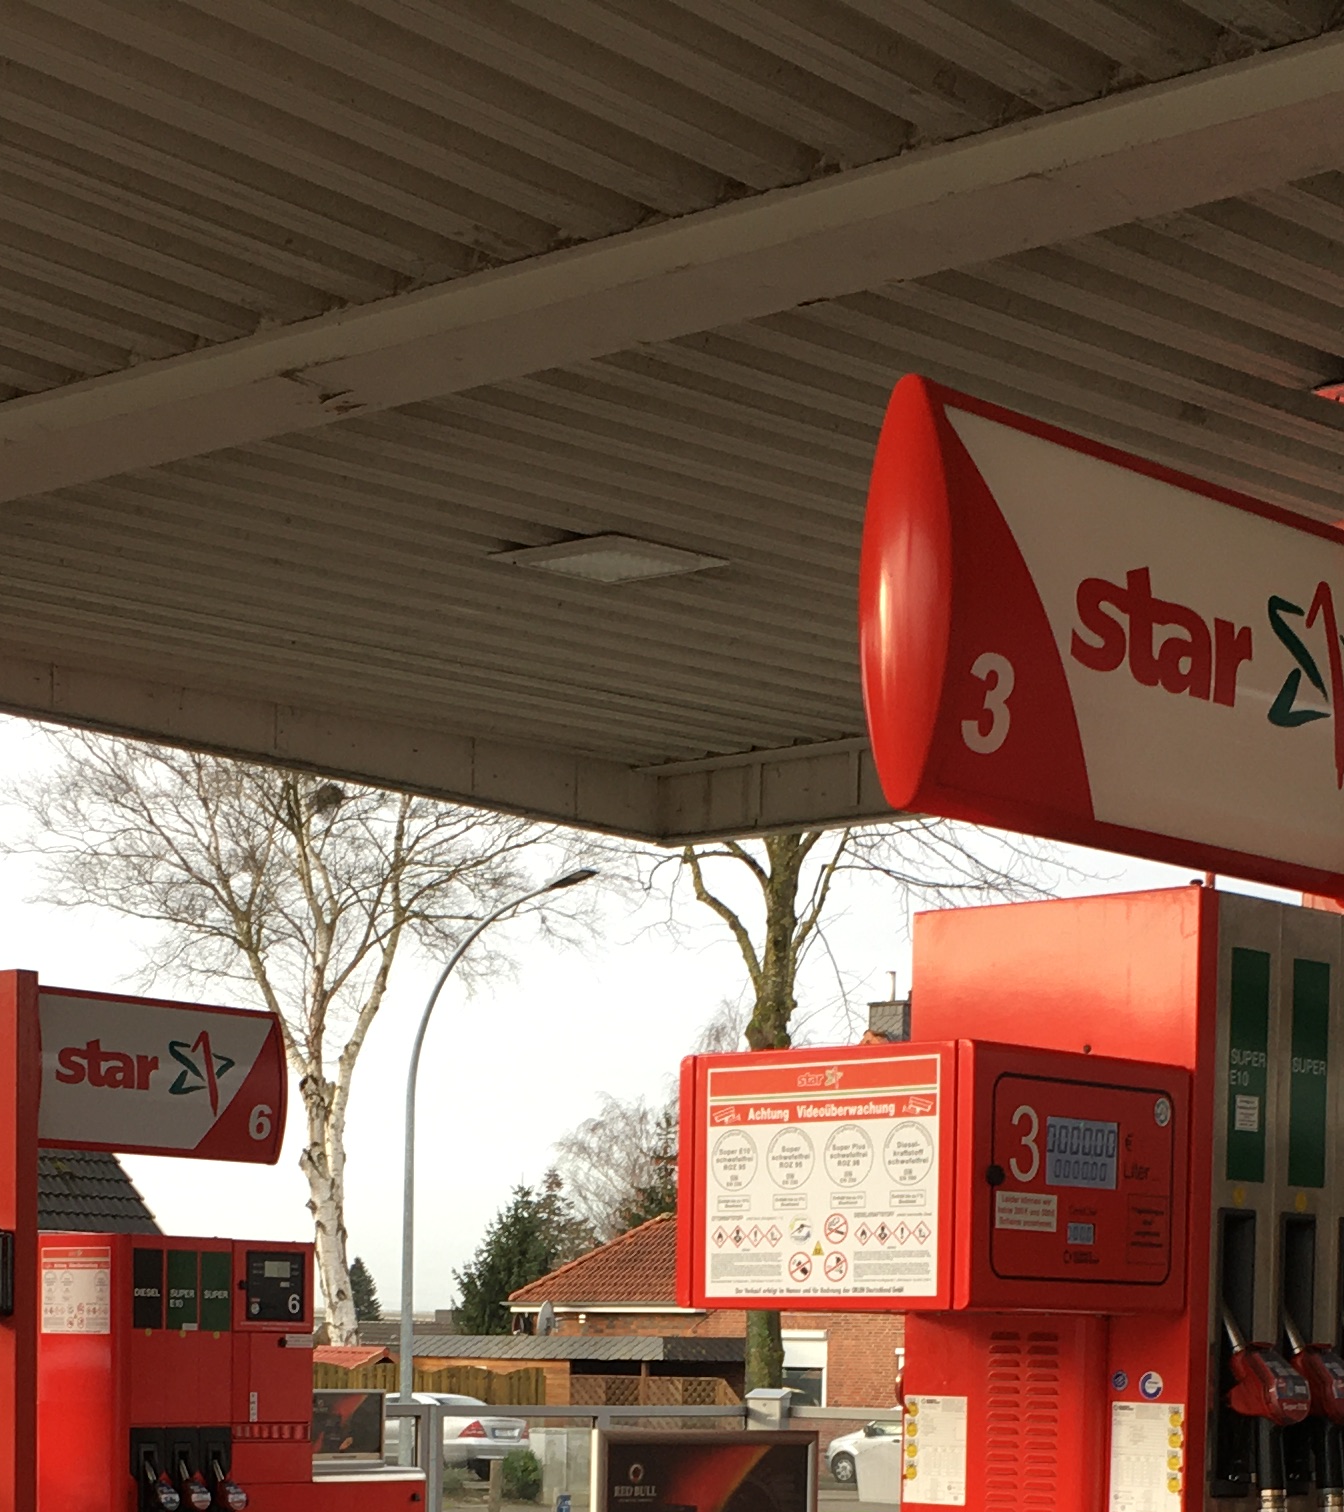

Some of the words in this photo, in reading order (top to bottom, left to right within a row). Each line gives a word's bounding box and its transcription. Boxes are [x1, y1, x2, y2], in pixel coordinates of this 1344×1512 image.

[1070, 566, 1253, 706] star
[960, 652, 1015, 755] 3
[56, 1038, 159, 1091] star
[1231, 1048, 1266, 1068] SUPER
[1292, 1057, 1326, 1076] SUPER
[797, 1072, 824, 1088] star
[1229, 1070, 1249, 1086] E10
[747, 1107, 789, 1121] Achtung
[796, 1102, 895, 1119] Videoüberwachung
[248, 1104, 272, 1140] 6
[1009, 1104, 1040, 1182] 3
[1124, 1163, 1150, 1181] Liter
[134, 1288, 161, 1298] DIESEL
[170, 1288, 195, 1298] SUPER
[204, 1289, 229, 1299] SUPER
[169, 1299, 183, 1308] E10
[287, 1293, 300, 1314] 6
[614, 1486, 633, 1498] RED
[633, 1485, 657, 1497] BULL
